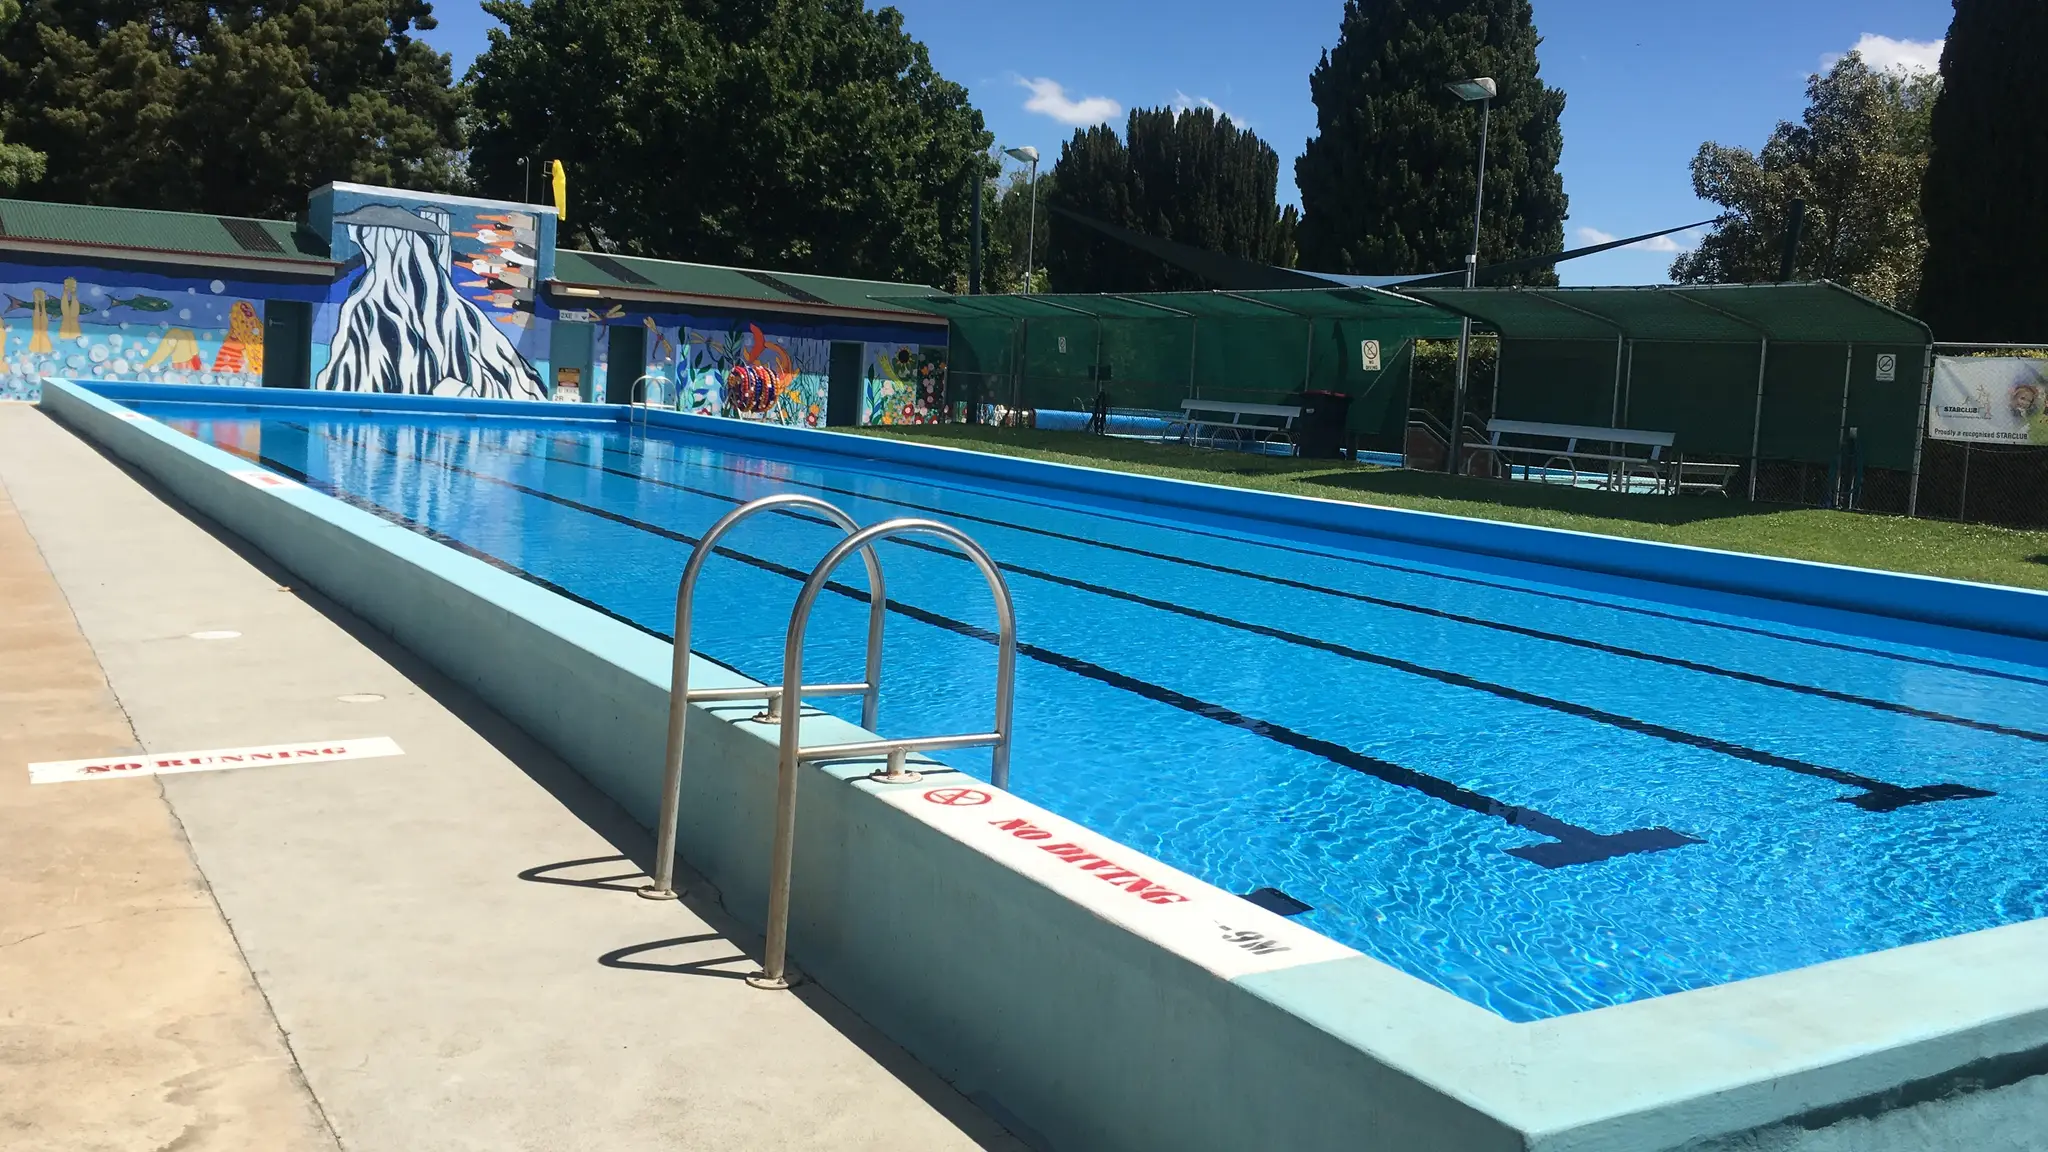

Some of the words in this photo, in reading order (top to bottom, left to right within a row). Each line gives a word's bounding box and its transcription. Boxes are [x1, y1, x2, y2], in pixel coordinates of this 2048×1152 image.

[1943, 406, 1978, 414] STARCLUB
[1934, 428, 1955, 437] Proudly
[1996, 432, 2028, 440] STARCLUB
[82, 763, 142, 775] NO
[156, 747, 347, 767] RUNNING
[988, 818, 1053, 840] NO
[1037, 843, 1192, 904] DIVING
